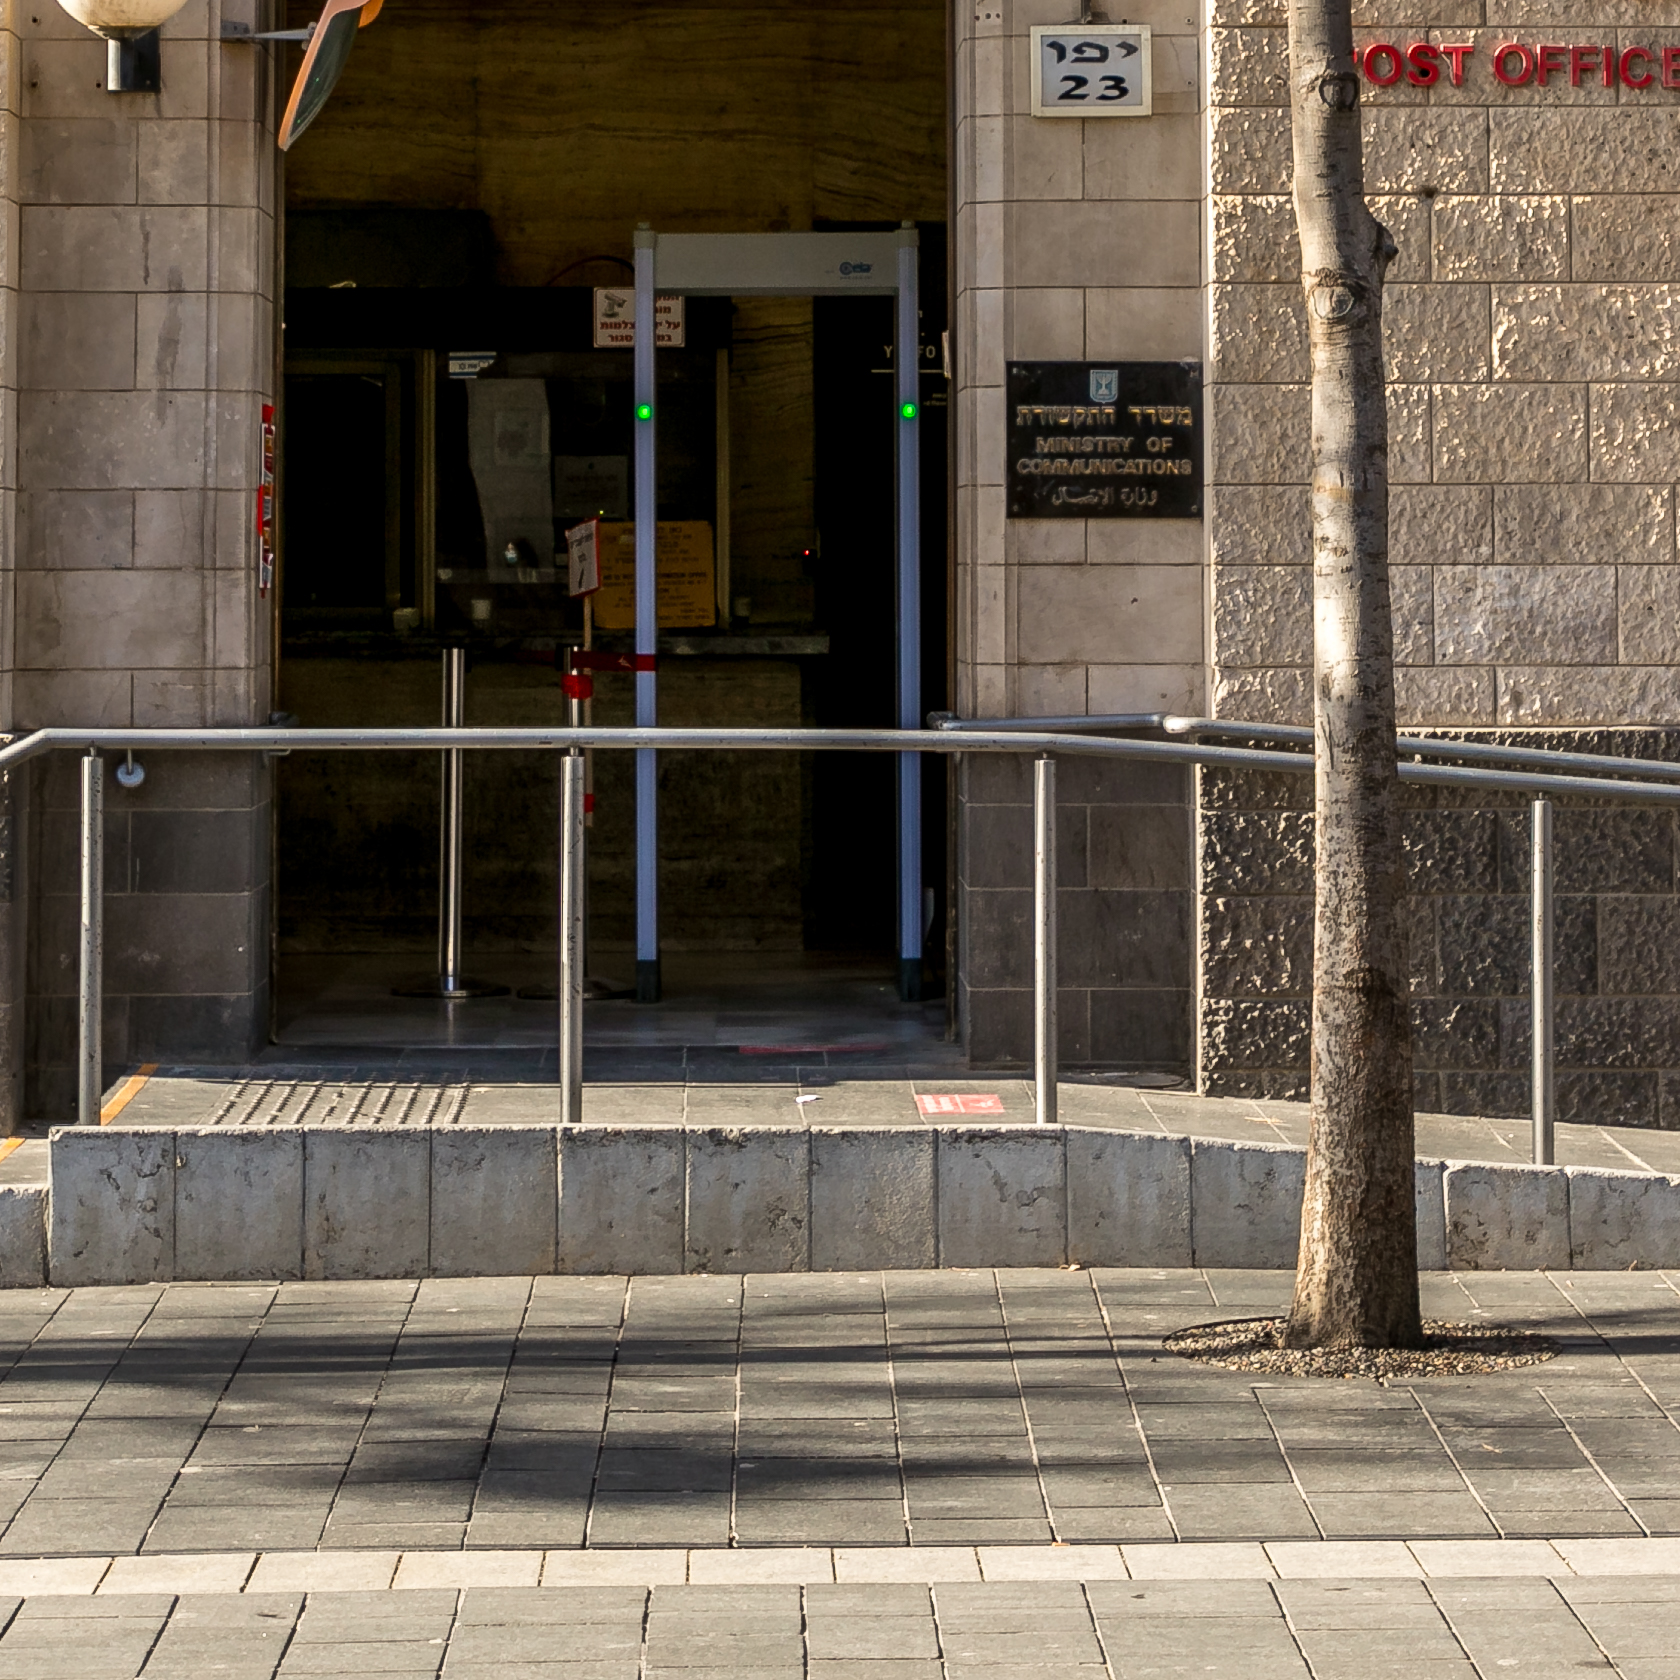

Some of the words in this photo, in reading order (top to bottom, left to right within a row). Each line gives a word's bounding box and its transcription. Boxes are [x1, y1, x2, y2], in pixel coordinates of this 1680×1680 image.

[1046, 40, 1139, 64] יפו
[1353, 42, 1475, 87] OST
[1057, 75, 1129, 101] 23
[1017, 406, 1116, 429] התקשורת
[1128, 406, 1193, 426] משרד
[1036, 436, 1135, 453] MINISTRY
[1146, 436, 1173, 453] OF
[1017, 458, 1192, 475] COMMUNICATIONS
